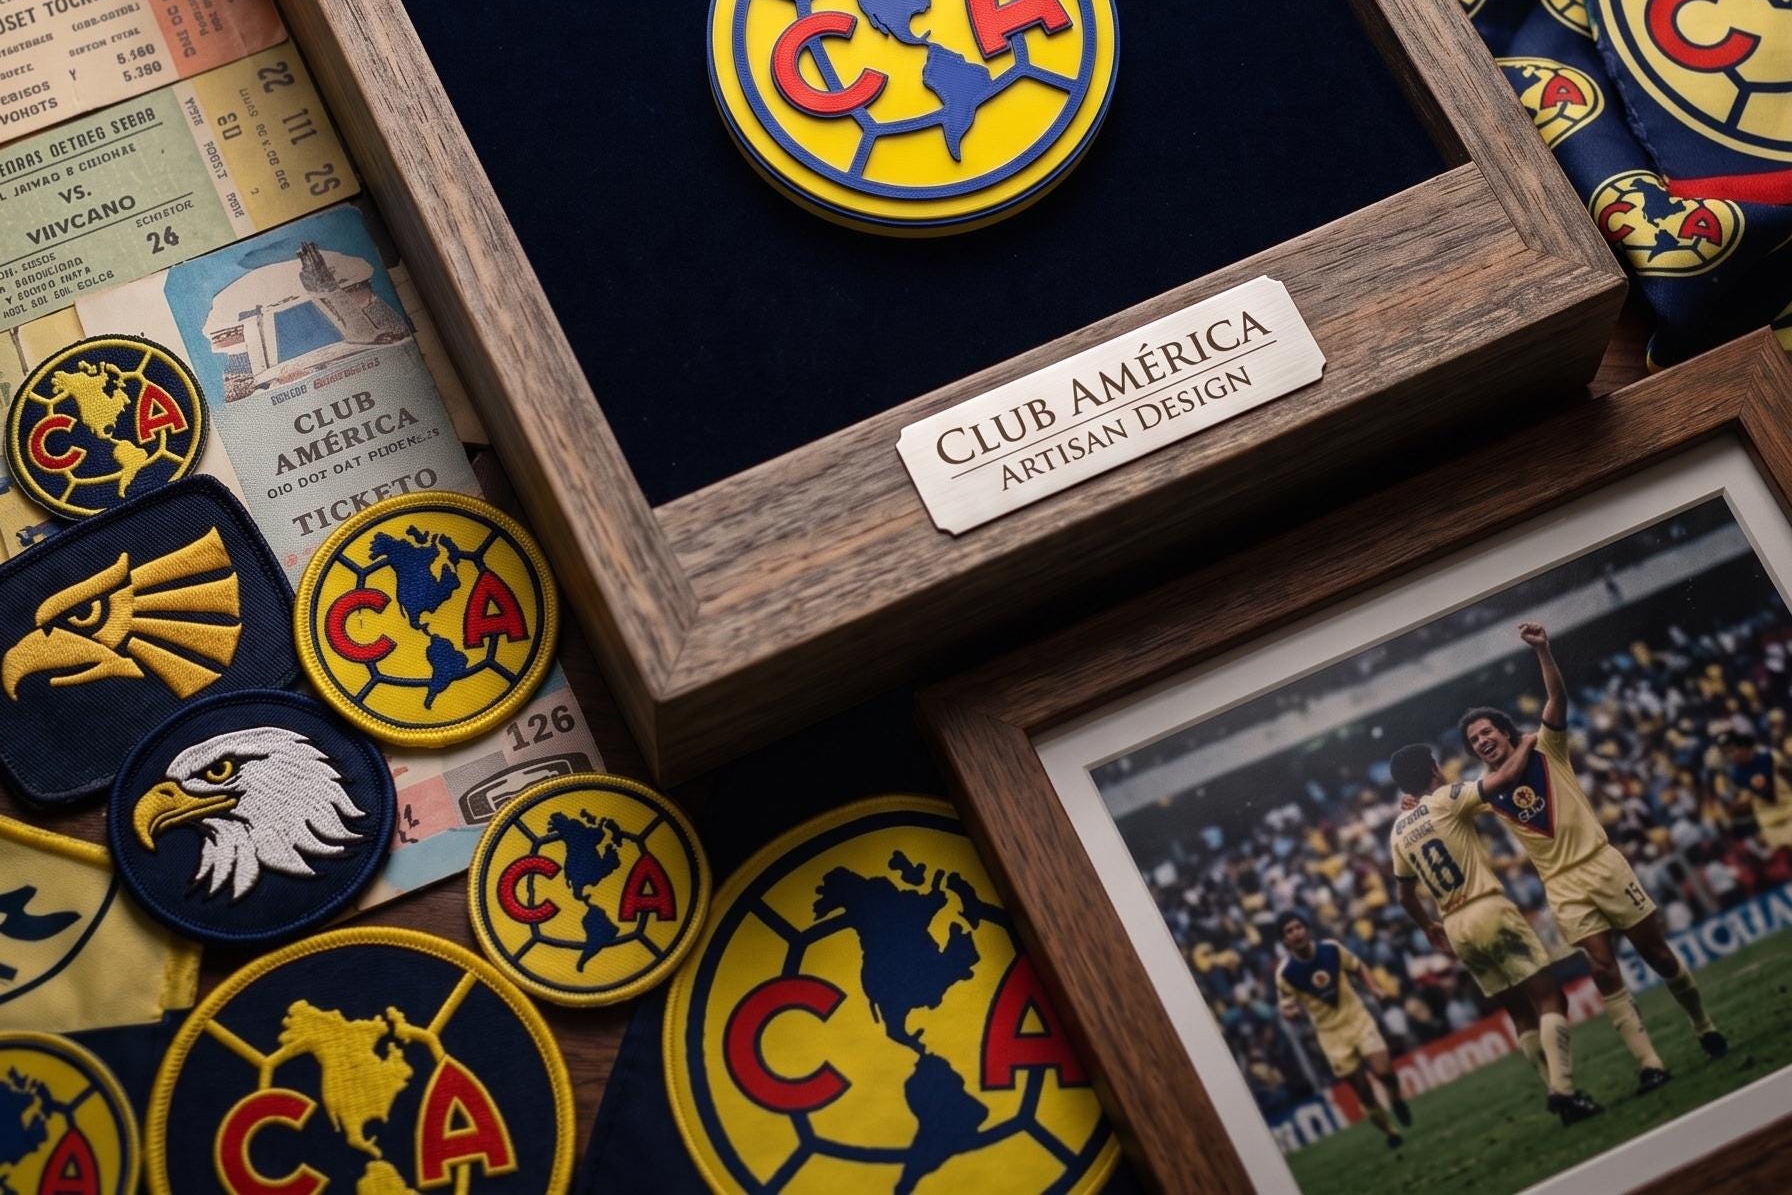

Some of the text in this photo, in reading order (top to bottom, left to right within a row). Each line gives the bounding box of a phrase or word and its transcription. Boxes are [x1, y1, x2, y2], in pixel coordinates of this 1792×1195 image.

[770, 11, 888, 118] C
[1539, 73, 1588, 111] A
[57, 184, 92, 205] VS.
[1597, 200, 1724, 248] C A
[293, 391, 377, 436] CLUB
[936, 309, 1273, 466] CLUB AMÉRICA
[28, 381, 190, 474] C A
[274, 407, 420, 477] AMÉRICA
[1000, 365, 1253, 492] ARTISAN DESIGN
[333, 456, 363, 475] OAT
[291, 467, 438, 537] TICKETO
[322, 569, 530, 663] C A
[506, 704, 576, 752] 126
[499, 854, 678, 925] C A
[1408, 838, 1466, 899] 18
[722, 951, 1094, 1116] C A
[213, 1053, 519, 1195] C A
[37, 1125, 102, 1195] A
